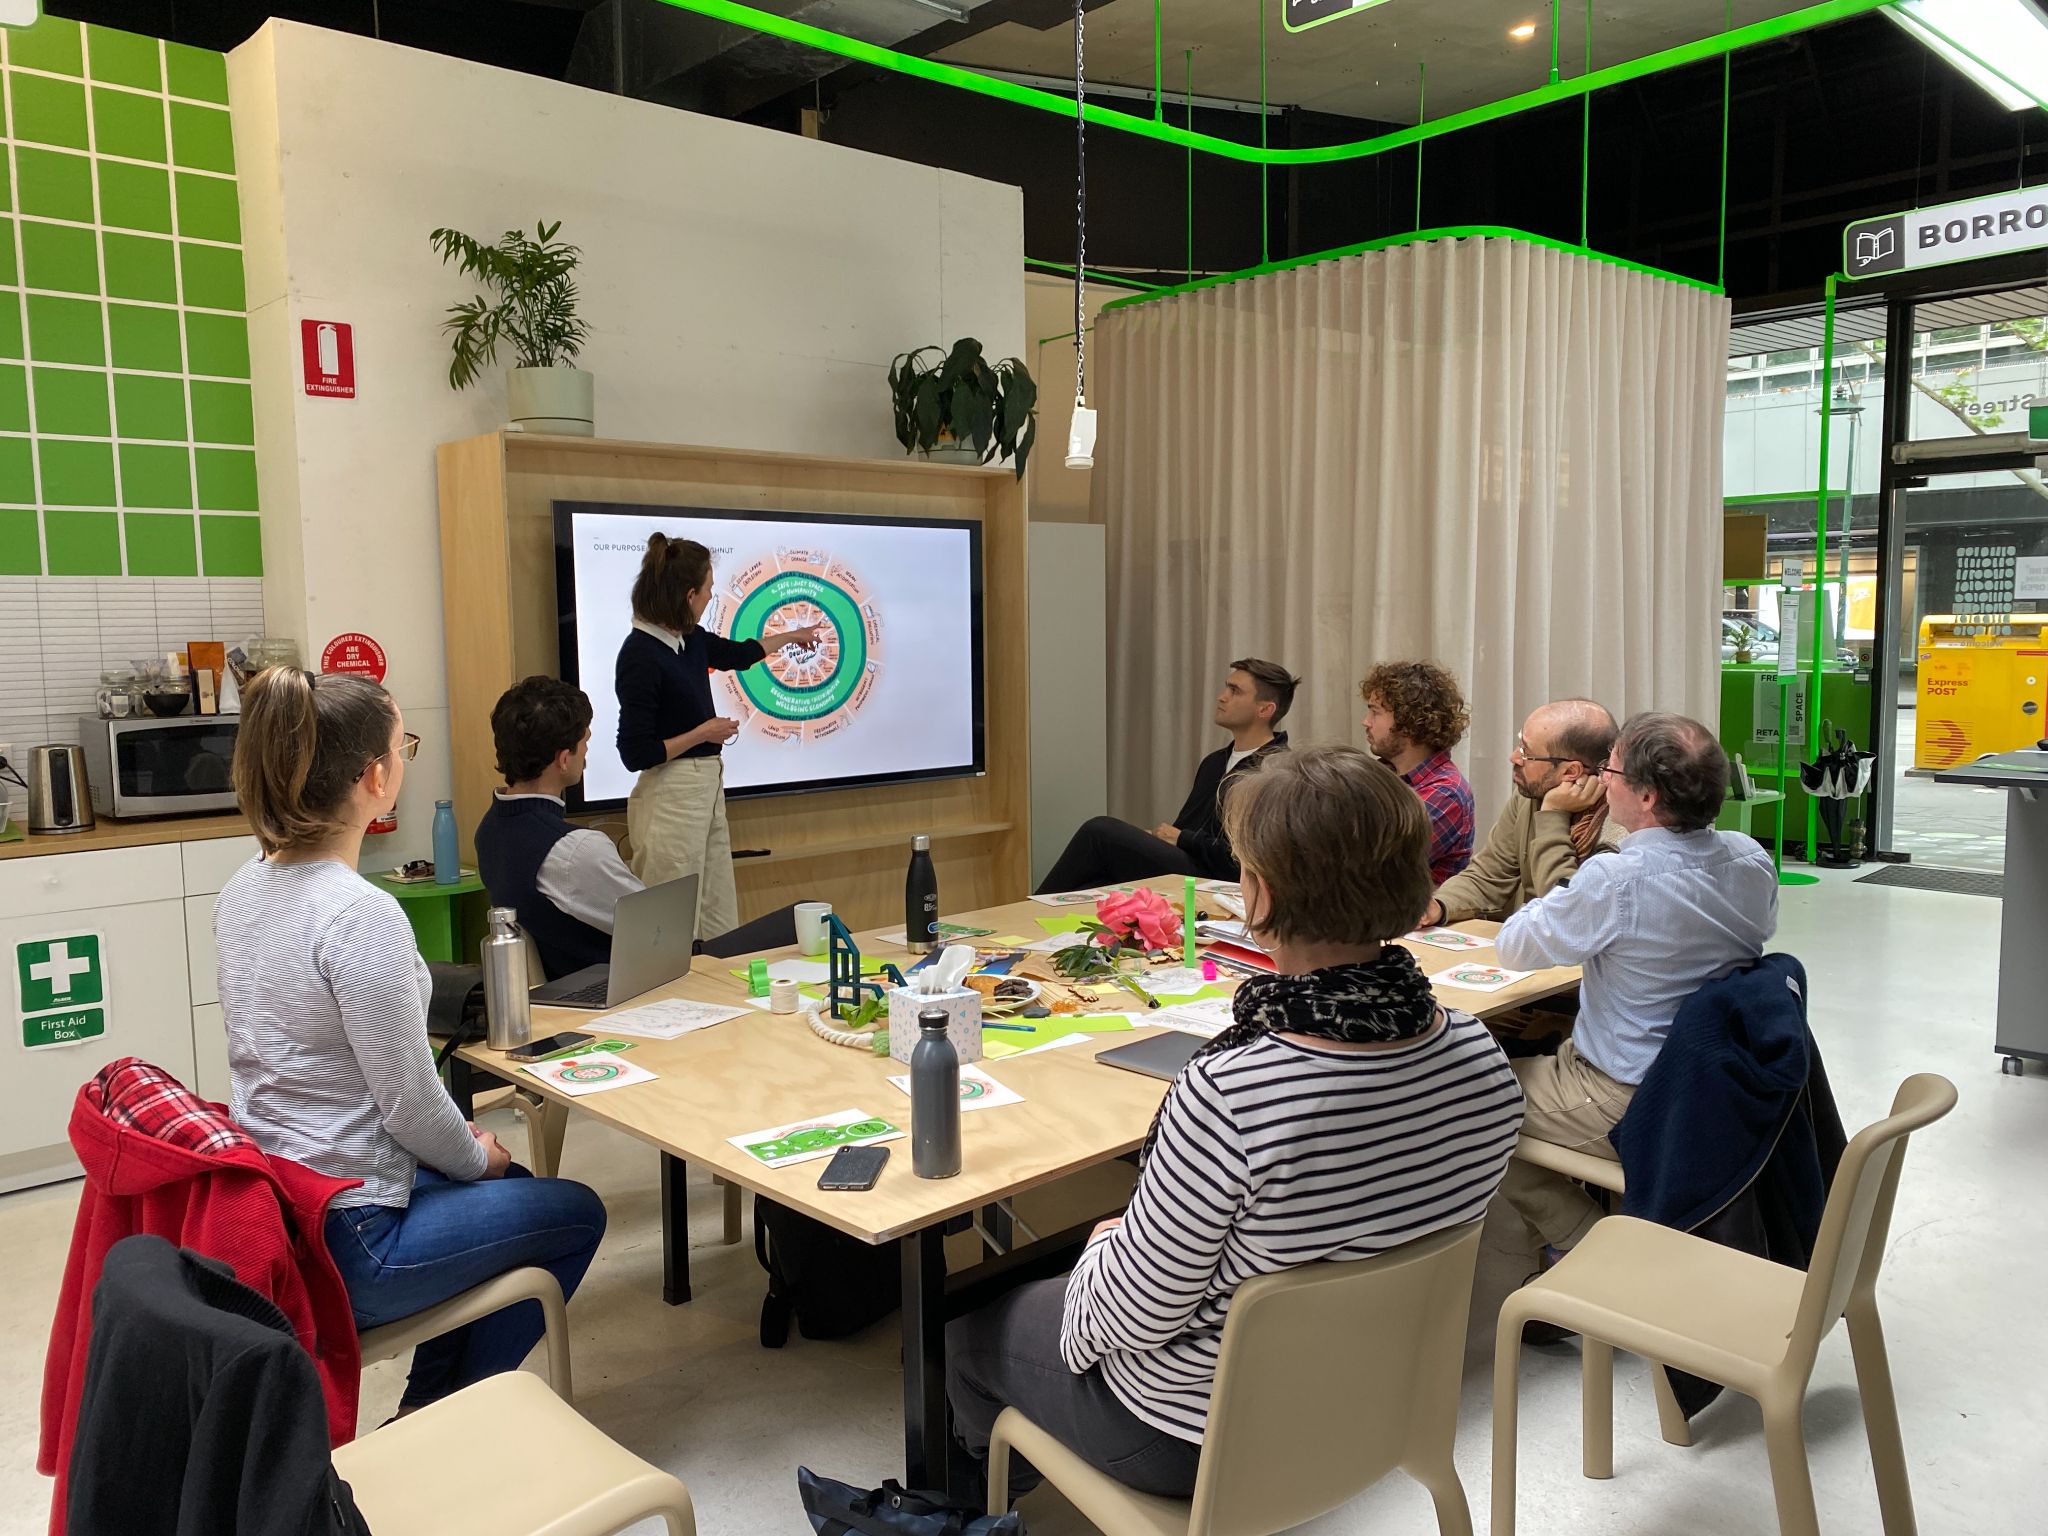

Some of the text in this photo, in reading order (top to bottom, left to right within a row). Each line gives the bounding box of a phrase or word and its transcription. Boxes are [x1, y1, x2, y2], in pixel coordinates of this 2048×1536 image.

[1918, 204, 2048, 249] BORRO
[322, 377, 337, 385] FIRE
[306, 384, 354, 394] EXTINGUISHER
[593, 543, 610, 551] OUR
[612, 544, 645, 552] PURPOSE
[326, 635, 353, 655] COLOURED
[354, 635, 384, 667] EXTINGUISHER
[336, 660, 371, 668] CHEMICAL
[1927, 677, 1969, 688] Express
[1927, 687, 1958, 696] POST
[1796, 693, 1804, 722] SPACE
[1756, 729, 1780, 737] RETA
[41, 1015, 86, 1031] First Aid
[54, 1029, 75, 1040] Box
